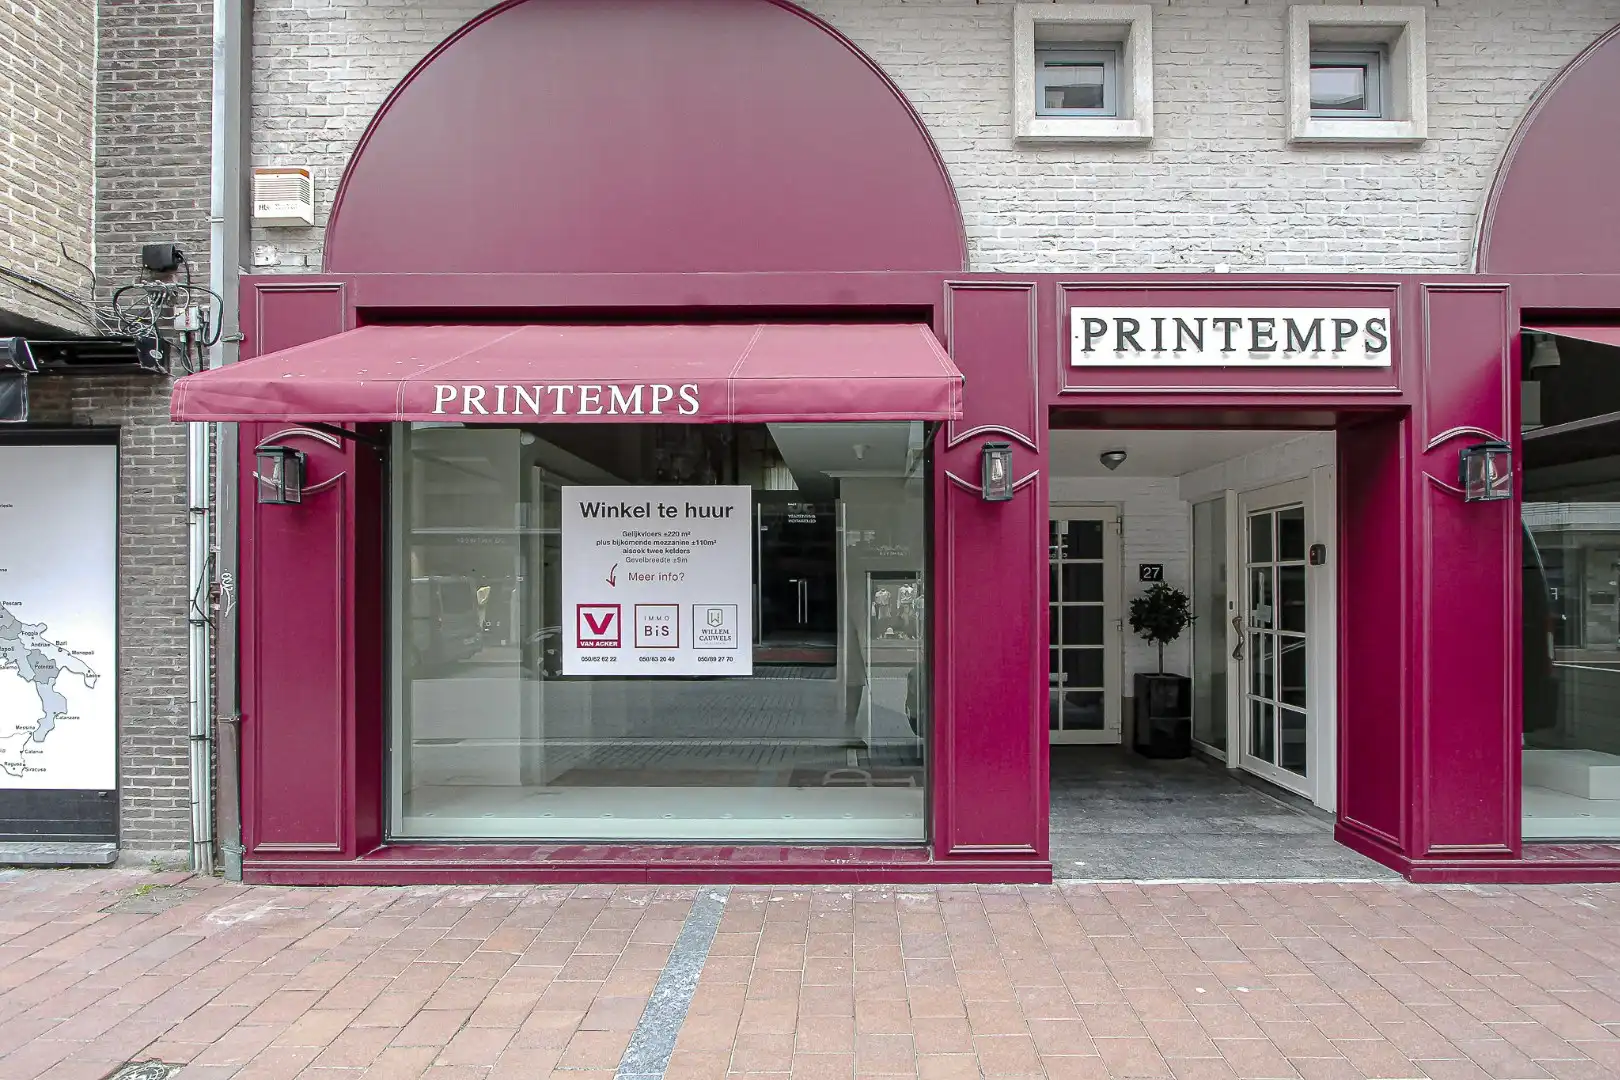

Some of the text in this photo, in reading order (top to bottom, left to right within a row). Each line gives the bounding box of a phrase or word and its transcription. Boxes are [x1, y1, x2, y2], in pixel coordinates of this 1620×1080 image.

[1080, 317, 1388, 353] PRINTEMPS
[431, 383, 700, 415] PRINTEMPS
[580, 502, 733, 518] Winkel te huur
[622, 531, 661, 539] Gelijkvloers
[612, 539, 651, 547] bijkomende
[628, 572, 685, 581] Meer info?
[1143, 567, 1160, 579] 27
[583, 613, 615, 635] V
